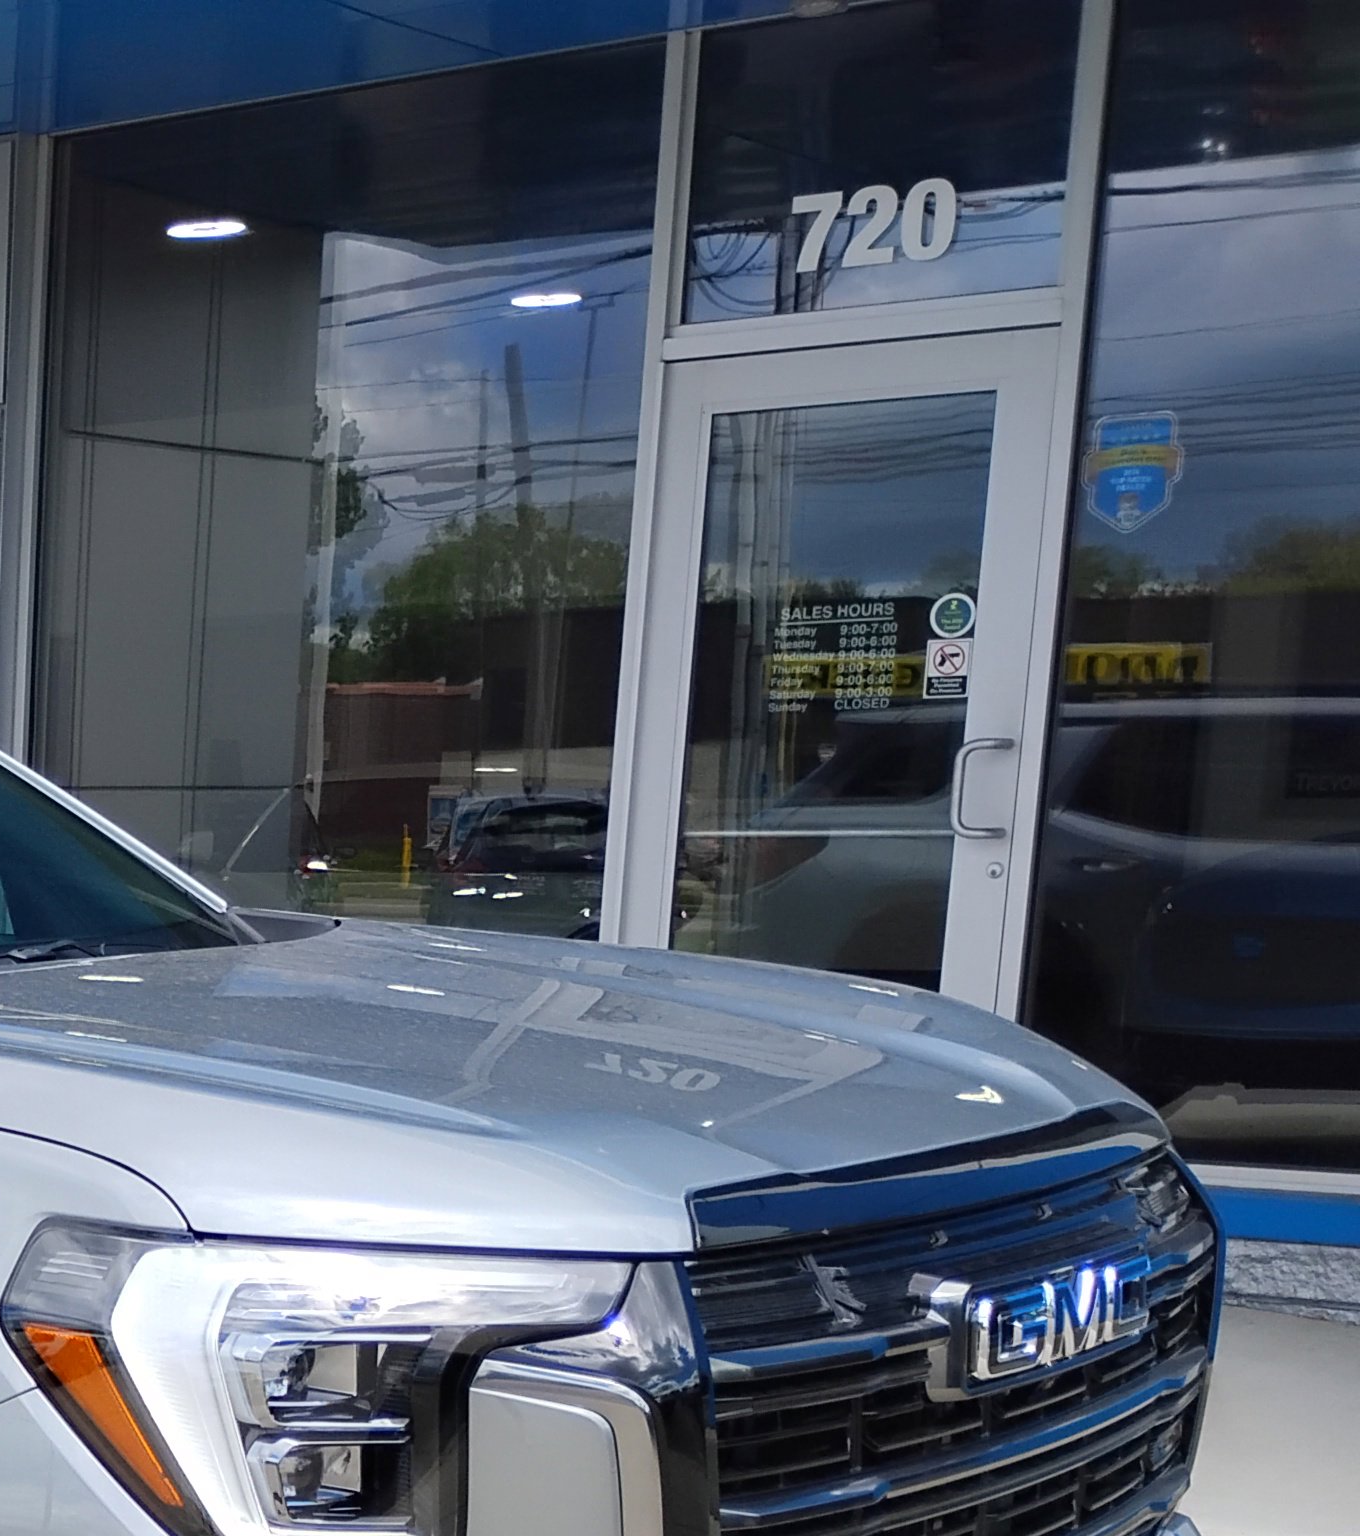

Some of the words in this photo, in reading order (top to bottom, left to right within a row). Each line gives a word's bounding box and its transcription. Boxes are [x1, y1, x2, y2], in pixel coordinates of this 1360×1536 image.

[792, 178, 956, 273] 720
[781, 604, 832, 621] SALES
[837, 602, 895, 618] HOURS
[774, 627, 817, 638] Monday
[840, 623, 898, 635] 9:00-7:00
[773, 639, 817, 650] Tuesday
[839, 636, 897, 647] 9:00-6:00
[773, 651, 834, 663] Wednesday
[838, 649, 896, 660] 9:00-6:00
[771, 664, 820, 676] Thursday
[837, 662, 895, 673] 9:00-7:00
[770, 677, 803, 689] Friday
[836, 674, 894, 686] 9:00-6:00
[769, 690, 816, 701] Saturday
[835, 687, 893, 699] 9:00-3:00
[768, 702, 808, 714] Sunday
[834, 698, 890, 711] CLOSED
[970, 1255, 1151, 1380] GMC
